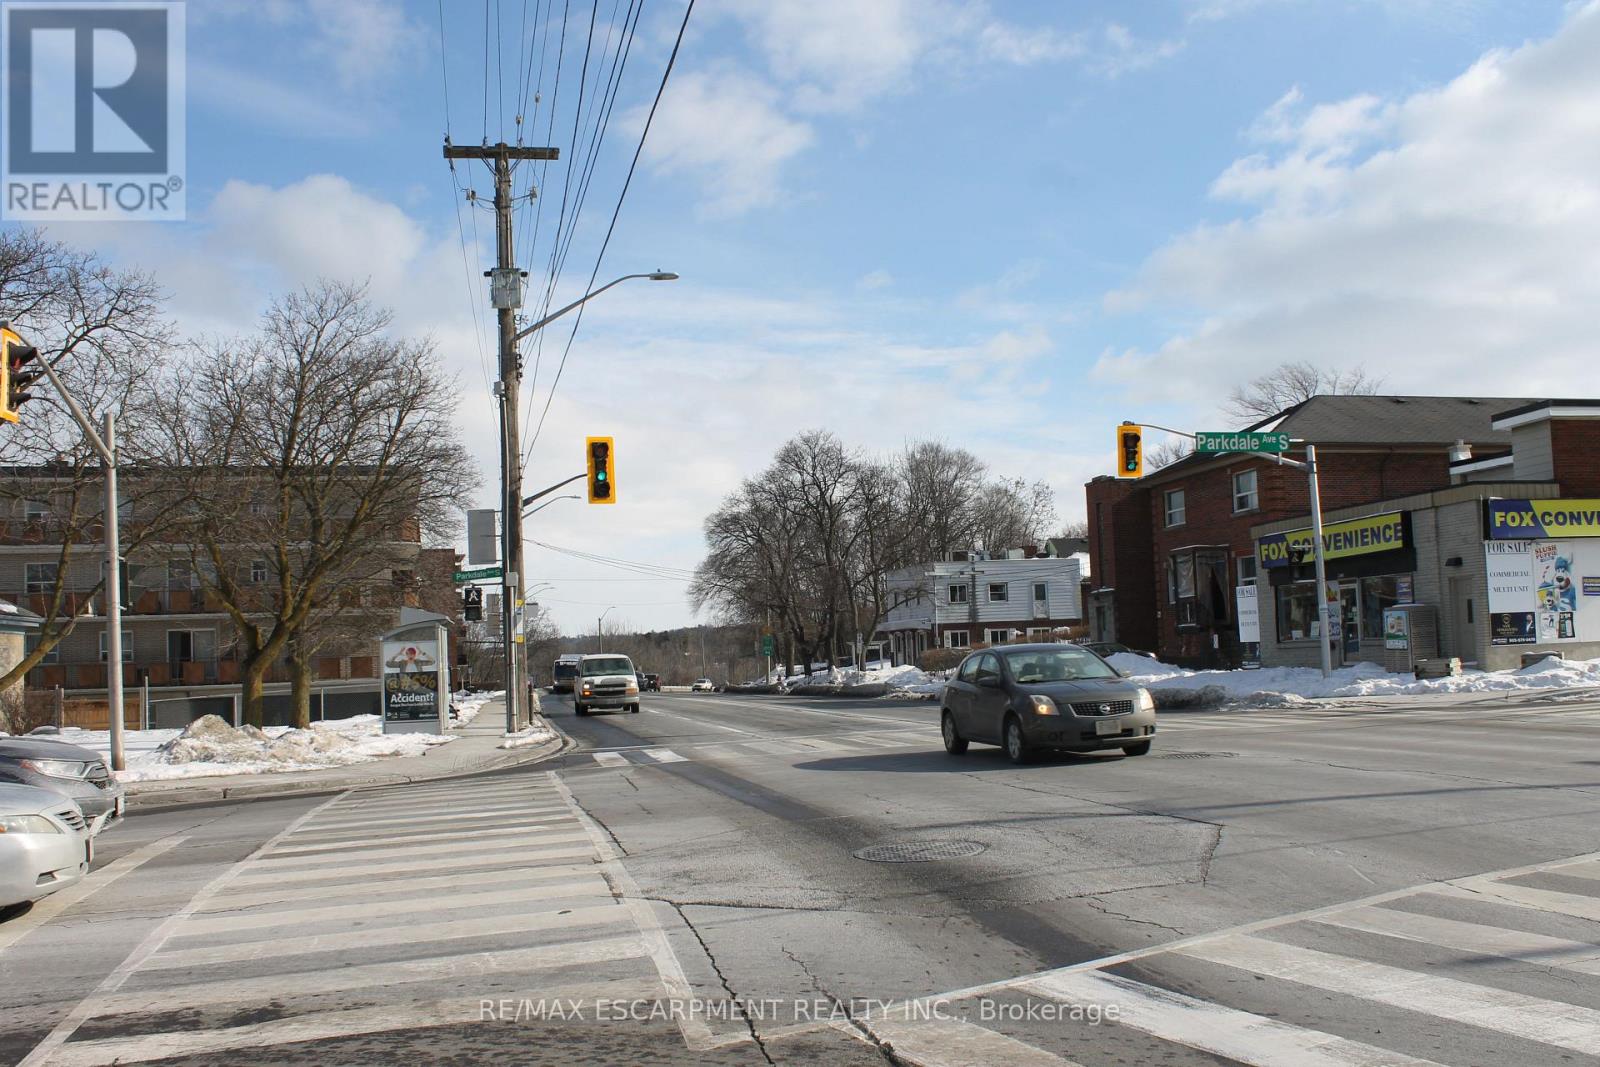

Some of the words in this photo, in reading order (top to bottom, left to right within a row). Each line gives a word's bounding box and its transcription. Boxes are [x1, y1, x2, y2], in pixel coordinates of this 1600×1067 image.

[1197, 435, 1259, 450] Parkdale
[1262, 435, 1276, 443] Ave
[1279, 436, 1288, 450] S
[1494, 511, 1535, 527] FOX
[1260, 542, 1288, 561] FOX
[1292, 523, 1402, 556] COVENIENCE
[1487, 542, 1506, 553] FOR
[1507, 541, 1530, 553] SALE
[456, 571, 487, 581] Parkdale
[390, 692, 435, 703] Accident?
